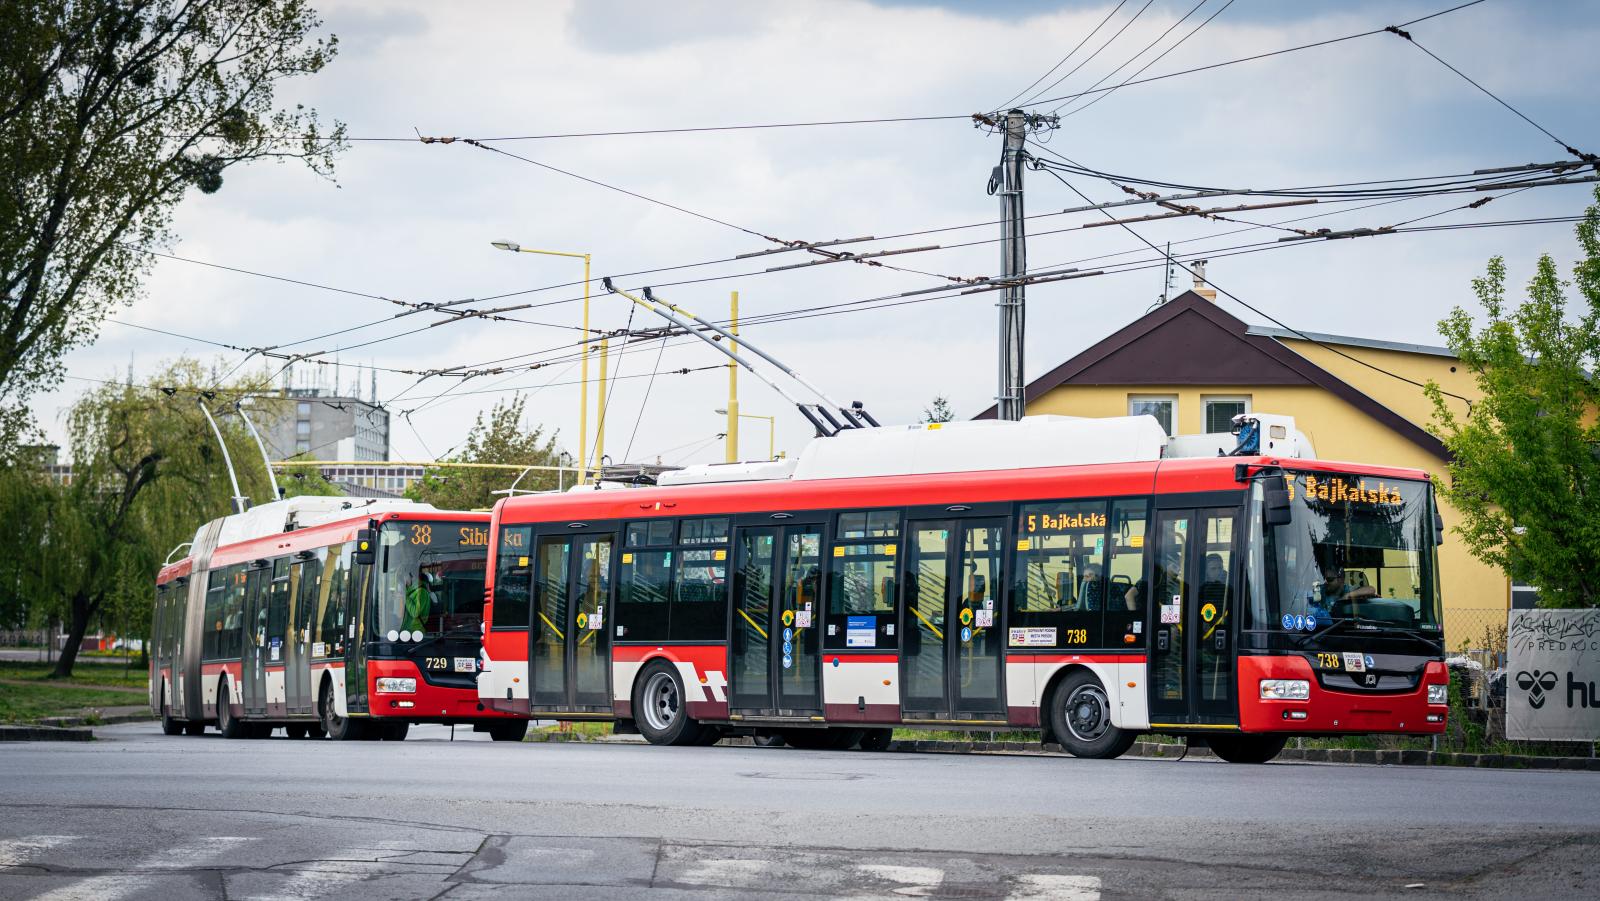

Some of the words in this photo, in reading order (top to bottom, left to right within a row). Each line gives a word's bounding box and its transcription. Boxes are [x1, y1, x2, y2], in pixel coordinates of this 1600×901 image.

[1306, 474, 1401, 505] Bajkalská
[1028, 515, 1036, 532] 5
[1042, 512, 1106, 530] Bajkalská
[411, 524, 432, 545] 38
[1067, 629, 1087, 644] 738
[426, 657, 447, 669] 729
[1317, 653, 1340, 668] 738
